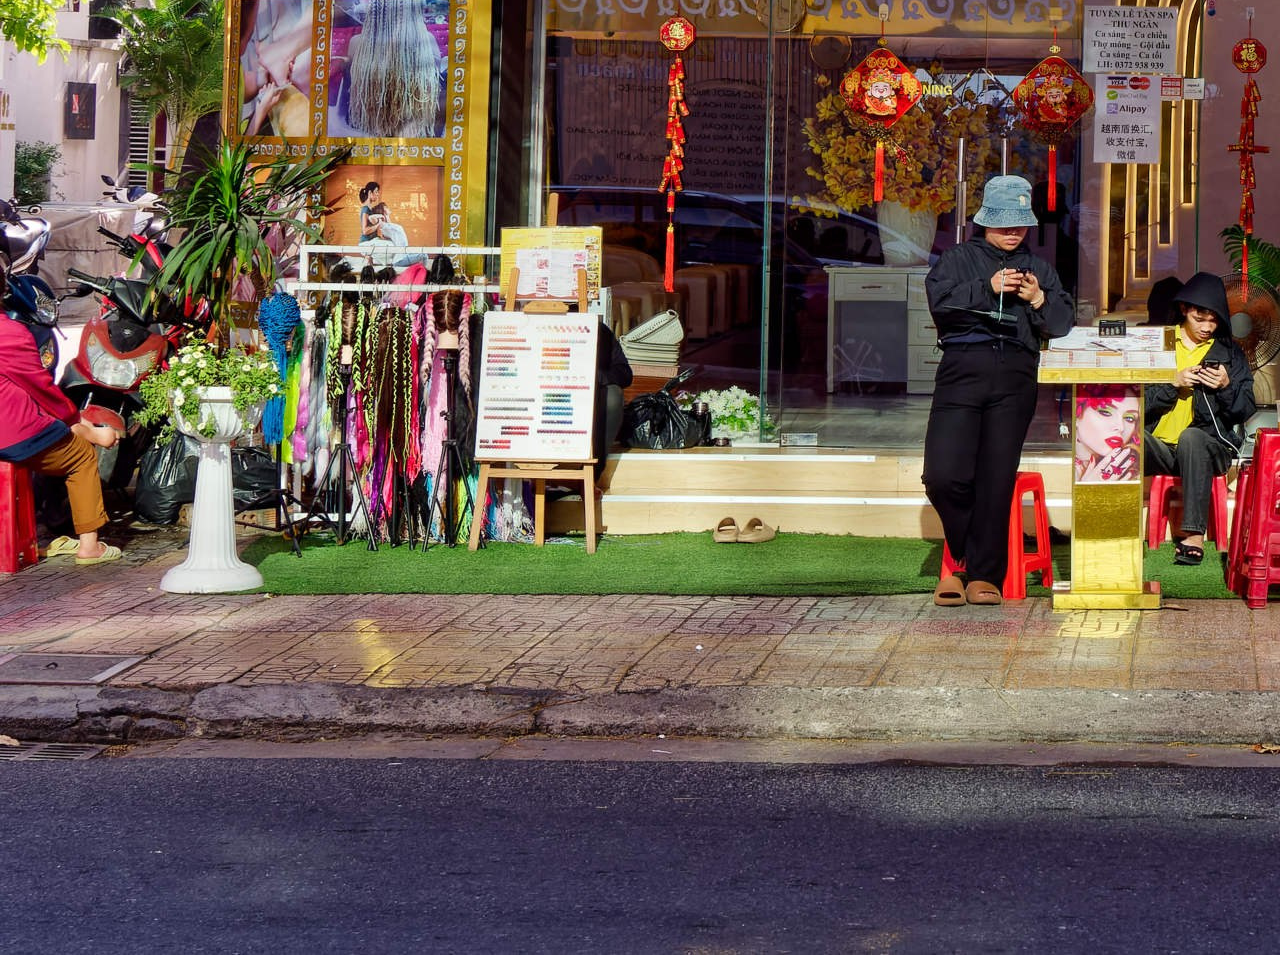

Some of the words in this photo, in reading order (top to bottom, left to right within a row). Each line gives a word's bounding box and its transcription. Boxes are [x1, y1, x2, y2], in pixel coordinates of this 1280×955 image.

[1157, 10, 1175, 20] SPA
[1114, 61, 1133, 70] 0372
[1134, 61, 1149, 70] 938
[1150, 61, 1165, 70] 939
[1119, 104, 1147, 115] Alipay
